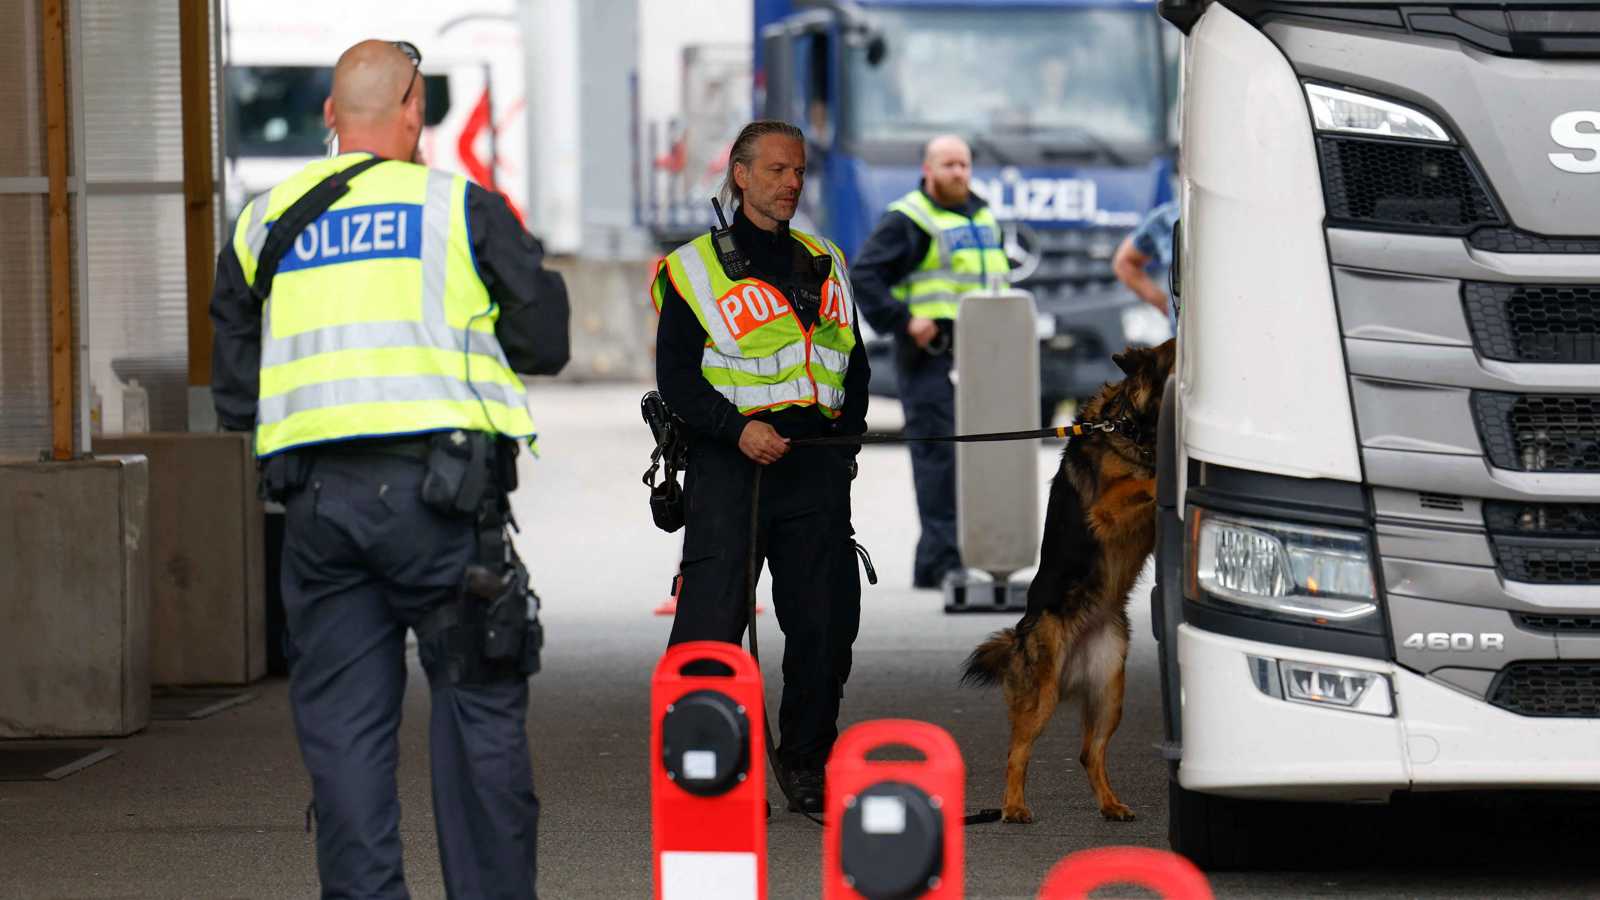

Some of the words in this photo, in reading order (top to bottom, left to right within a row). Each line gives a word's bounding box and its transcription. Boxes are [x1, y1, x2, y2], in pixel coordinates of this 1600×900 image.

[971, 177, 1097, 221] LIZEI
[293, 210, 408, 262] OLIZEI
[1403, 632, 1474, 650] 460
[1480, 632, 1504, 650] R
